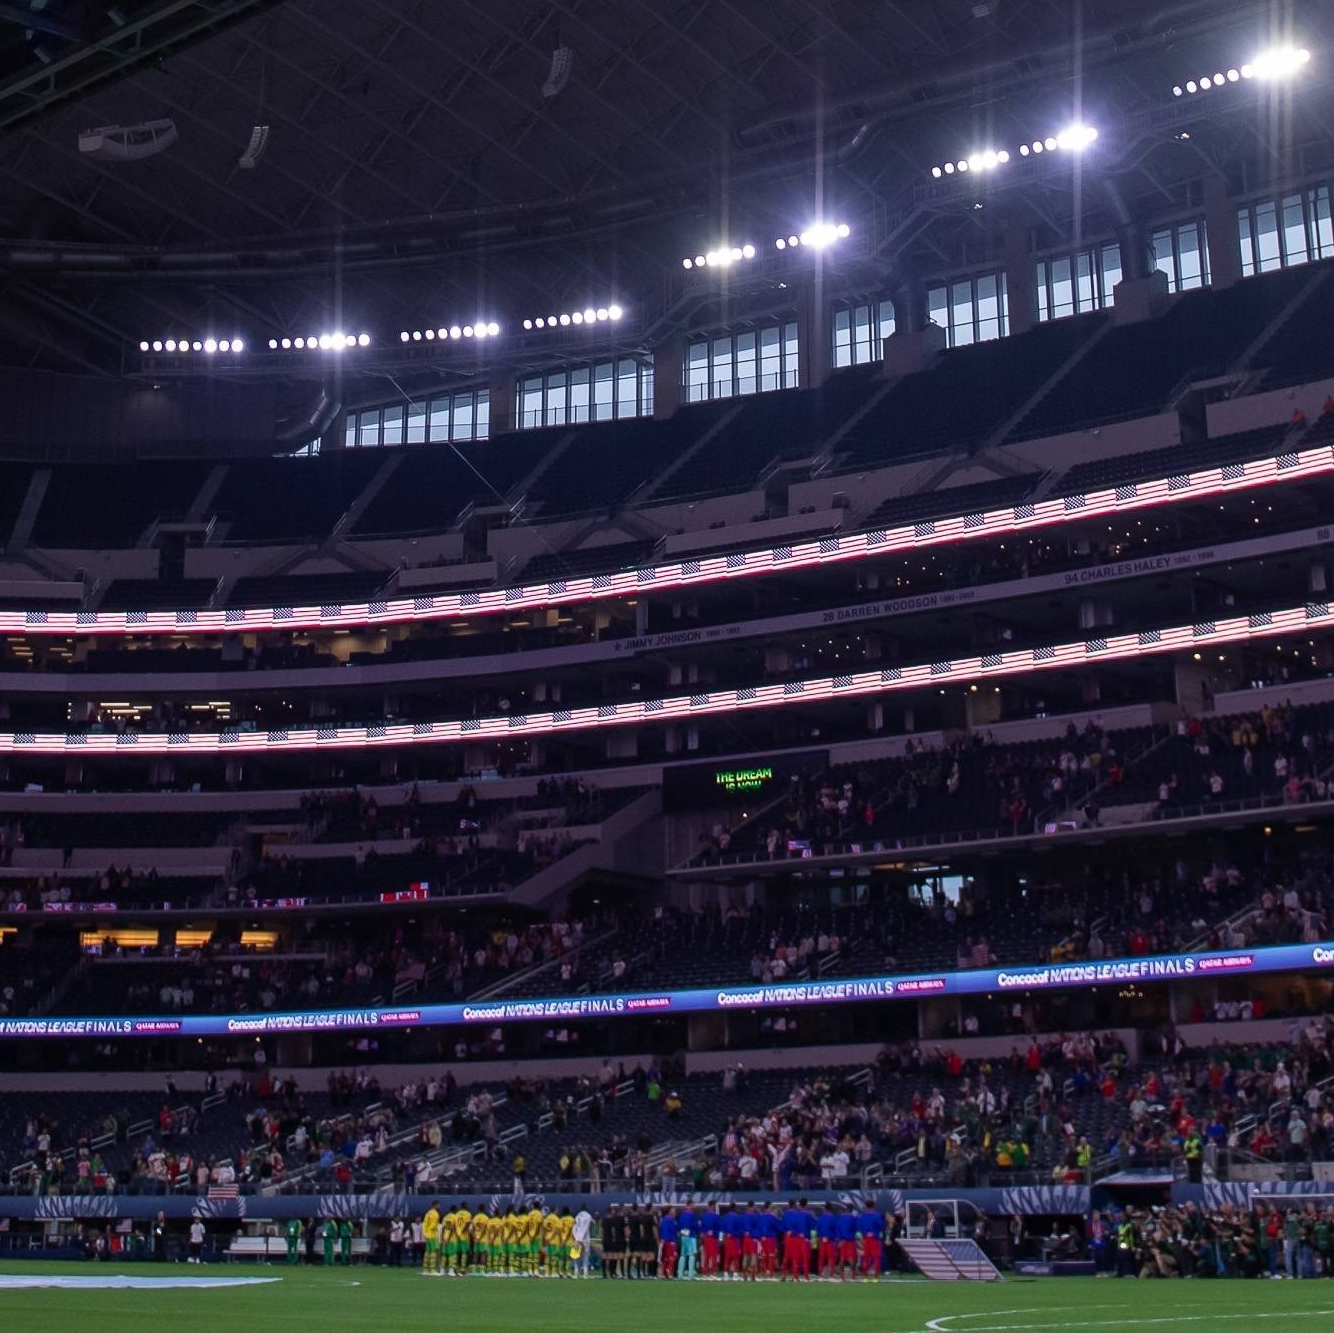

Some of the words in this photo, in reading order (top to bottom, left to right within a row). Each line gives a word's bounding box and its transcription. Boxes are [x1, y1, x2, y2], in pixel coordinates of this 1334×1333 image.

[1317, 528, 1329, 540] 88
[1081, 564, 1132, 581] CHARLES
[1134, 557, 1171, 573] HALEY
[837, 605, 880, 620] DARREN
[883, 596, 937, 612] WOODSON
[624, 638, 654, 650] JIMMY
[656, 630, 701, 646] JOHNSON
[998, 970, 1049, 987] Concacaf
[1050, 966, 1096, 983] NATIONS
[1096, 962, 1139, 979] LEAGUE
[1140, 958, 1195, 976] FINALS
[718, 989, 763, 1005] Concacaf
[765, 987, 806, 1002] NATIONS
[806, 984, 845, 999] LEAGUE
[845, 981, 894, 996] FINALS
[463, 1005, 505, 1020] Concacaf
[506, 1003, 544, 1016] NATIONS
[544, 1001, 580, 1015] LEAGUE
[581, 998, 624, 1012] FINALS
[5, 1021, 46, 1033] NATIONS
[47, 1021, 85, 1033] LEAGUE
[86, 1021, 132, 1033] FINALS
[228, 1016, 266, 1030] Concacaf
[267, 1015, 303, 1028] NATIONS
[303, 1014, 336, 1027] LEAGUE
[336, 1012, 378, 1026] FINALS
